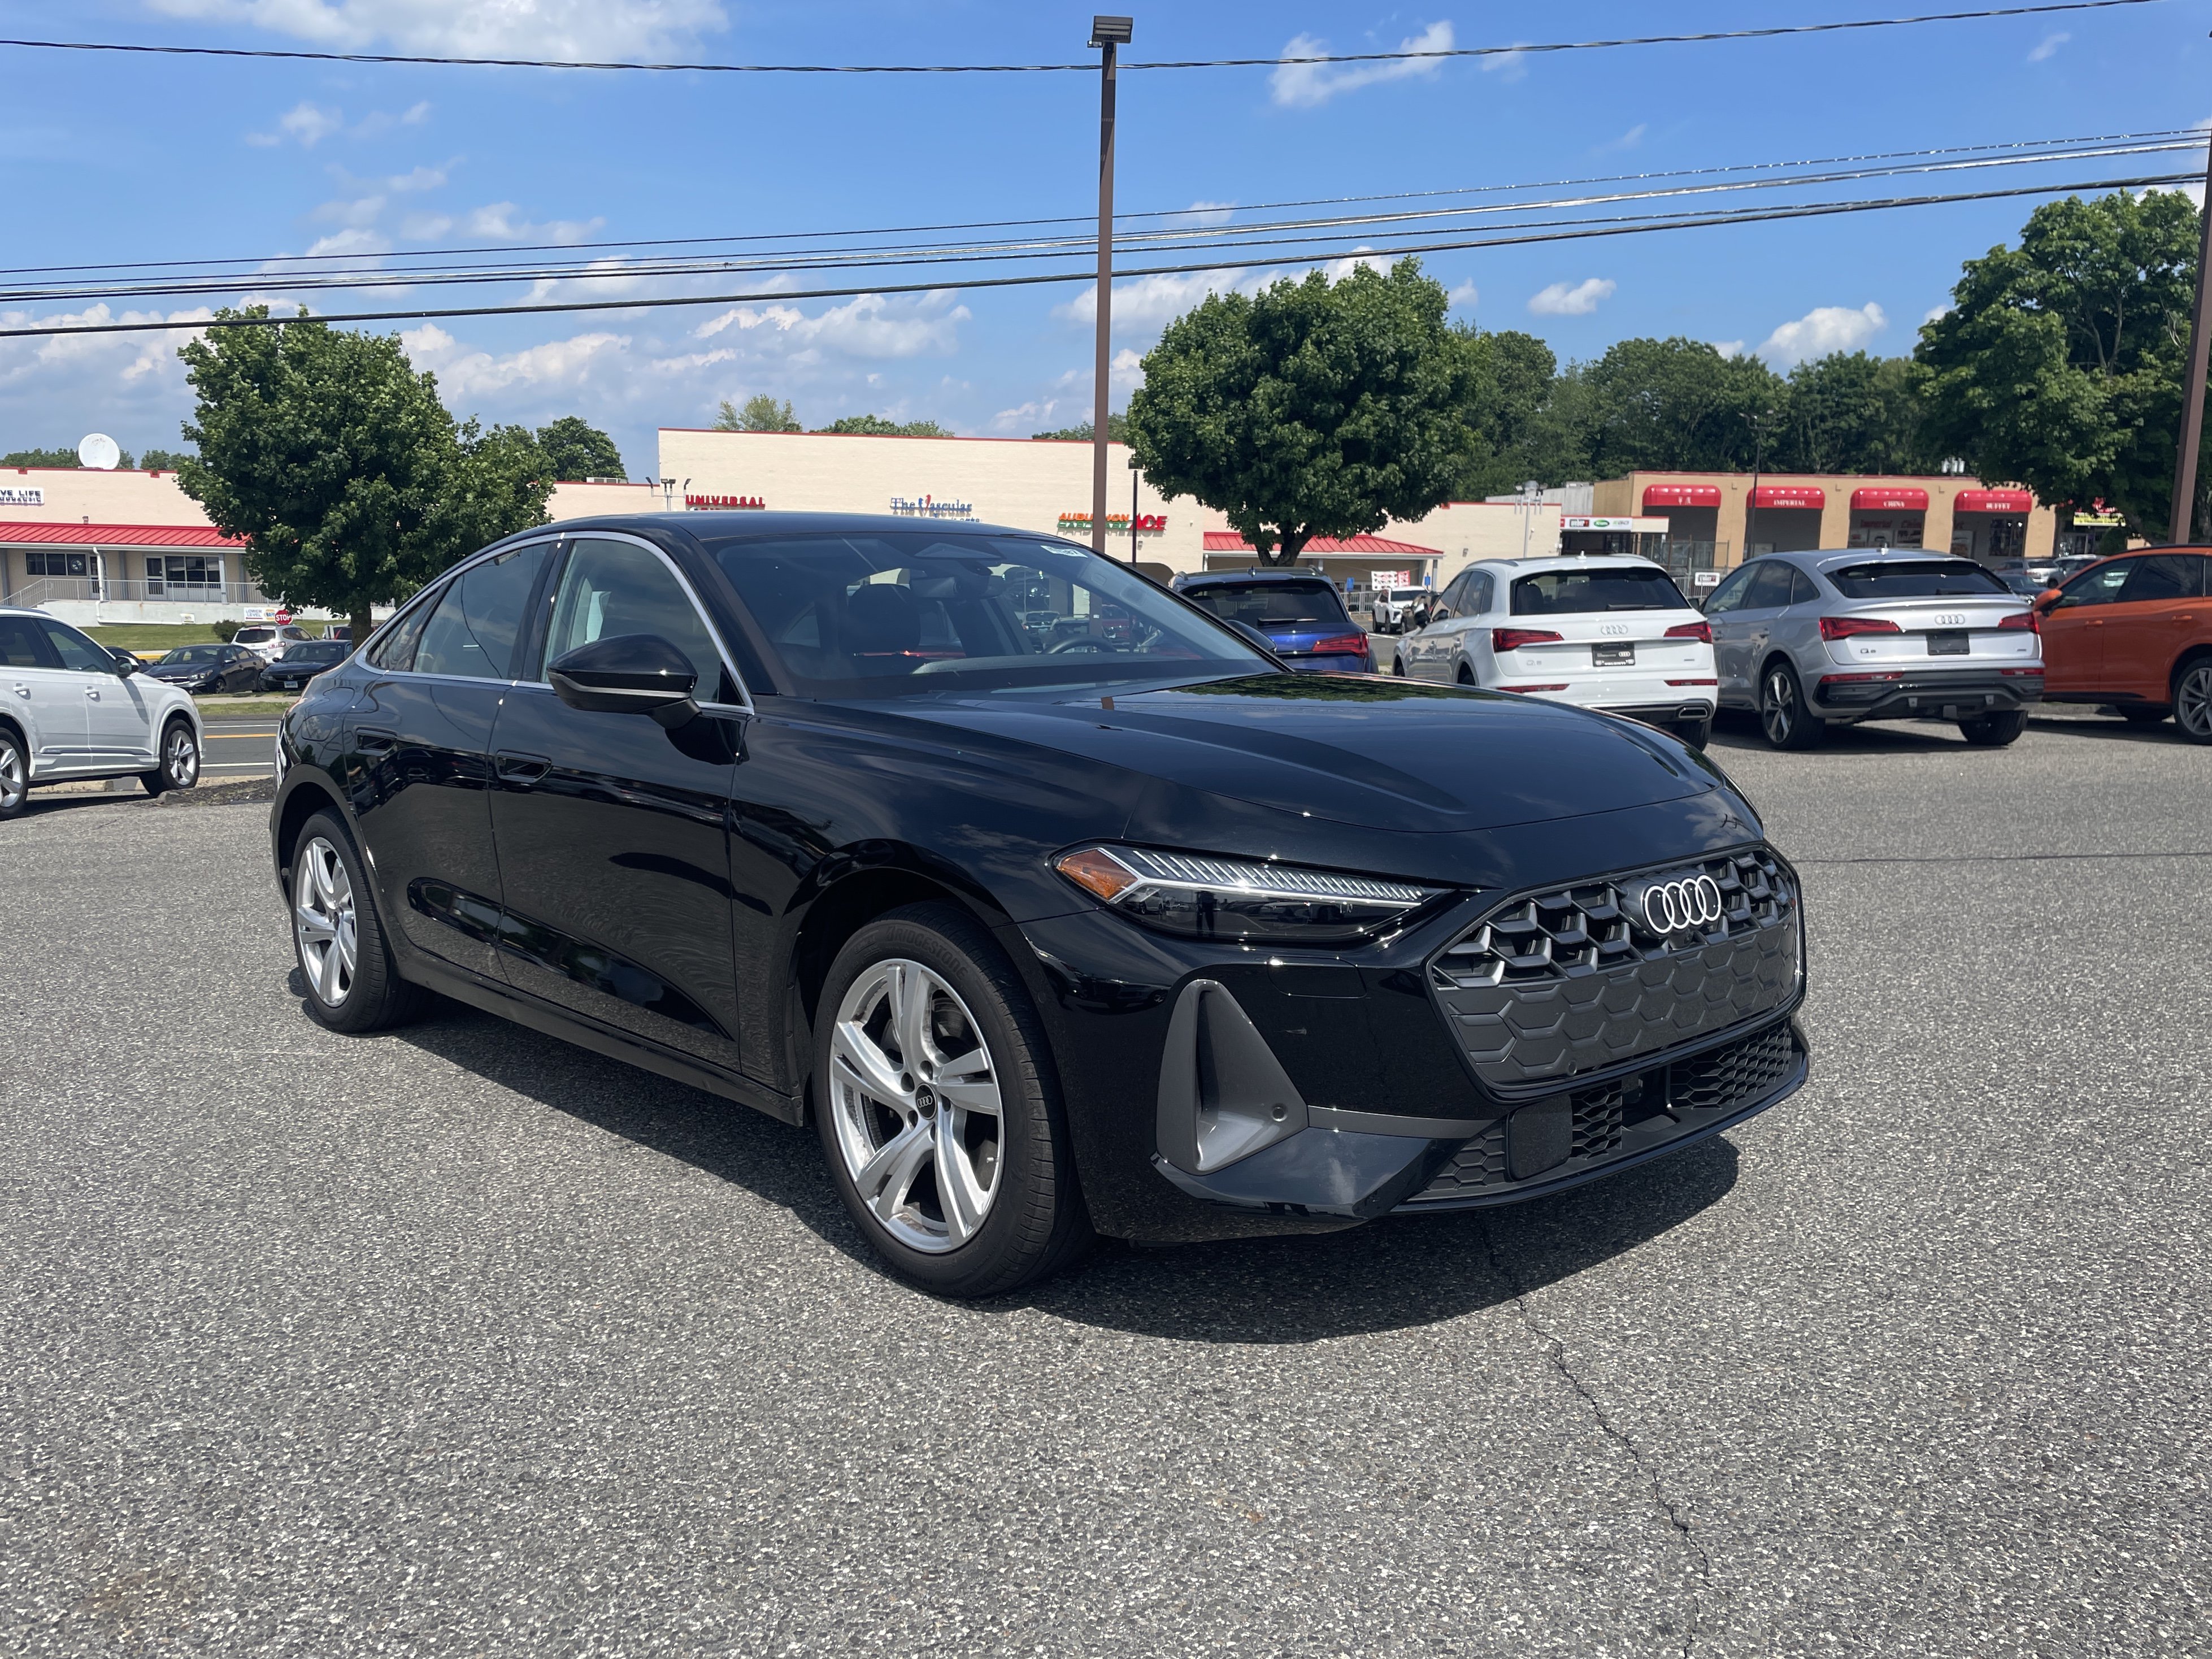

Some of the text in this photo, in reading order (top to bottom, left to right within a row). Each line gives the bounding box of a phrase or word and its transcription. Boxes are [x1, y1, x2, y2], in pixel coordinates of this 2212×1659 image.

[685, 494, 766, 507] UNIVERSAL
[890, 494, 972, 512] The Vascular
[1129, 513, 1168, 531] ACE
[886, 925, 968, 981] BRIDGESTONE
